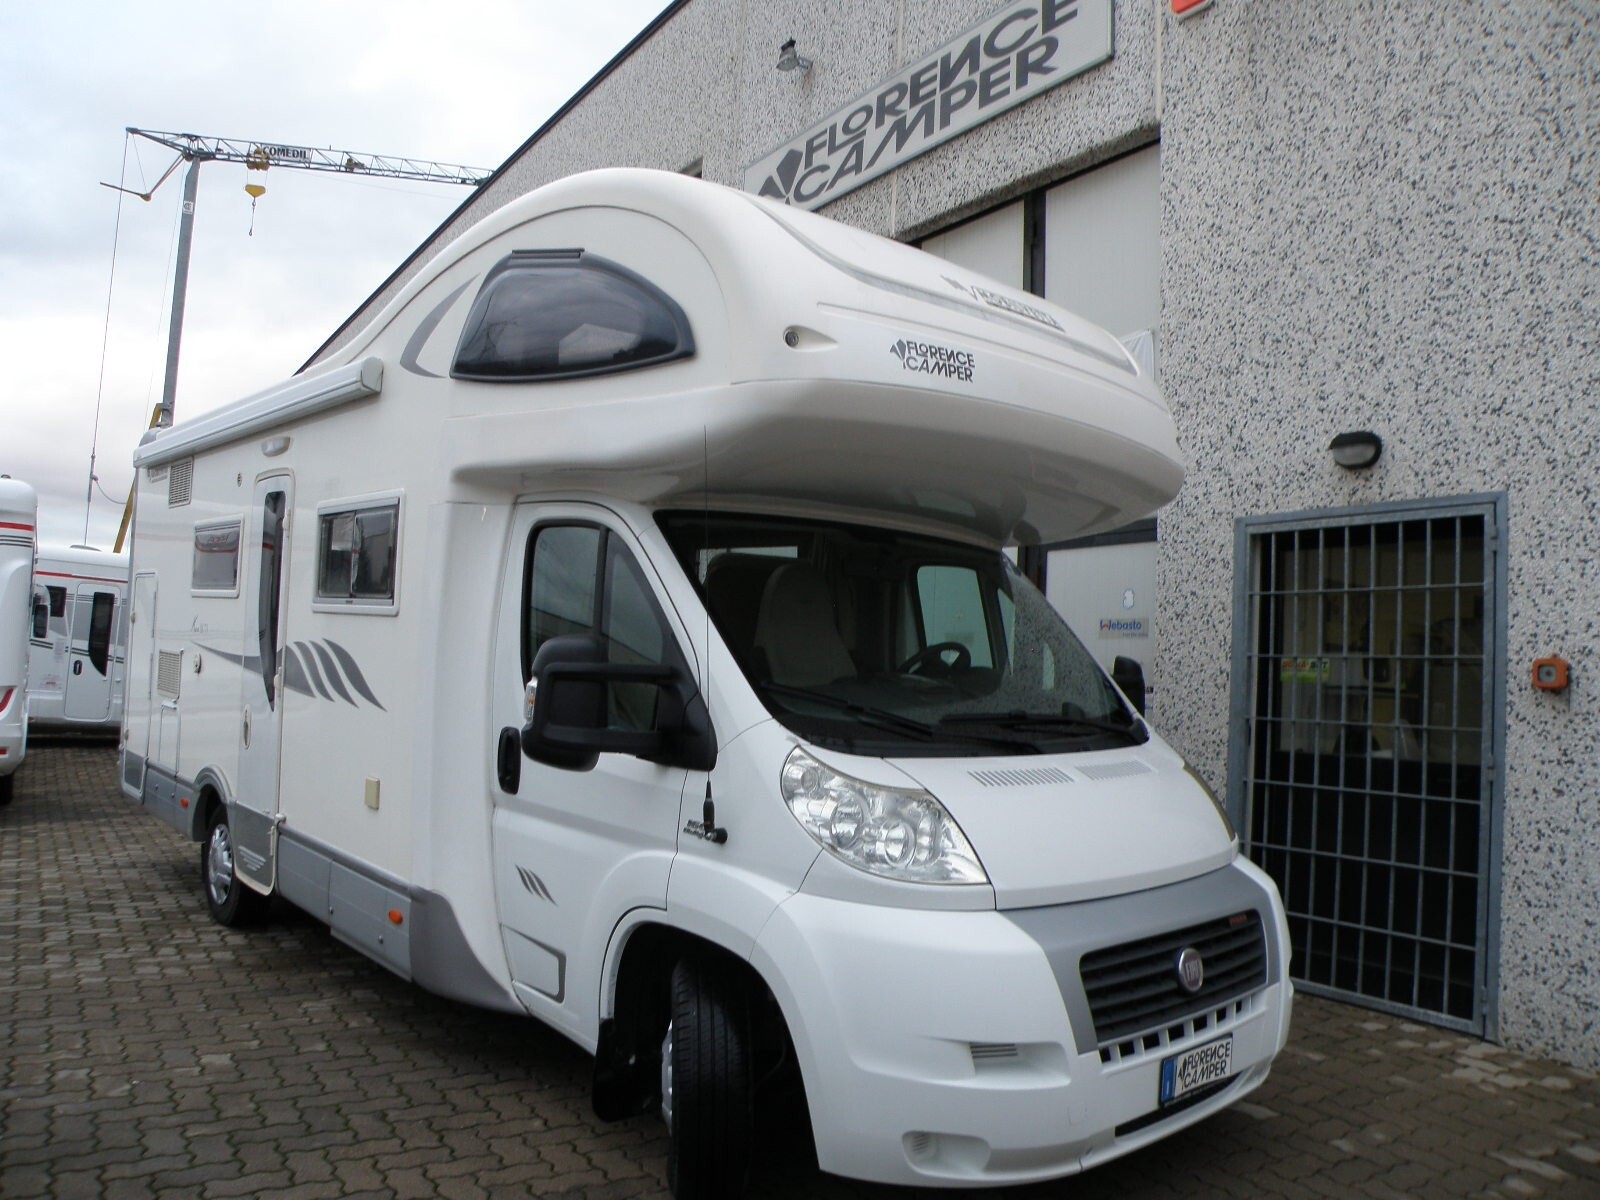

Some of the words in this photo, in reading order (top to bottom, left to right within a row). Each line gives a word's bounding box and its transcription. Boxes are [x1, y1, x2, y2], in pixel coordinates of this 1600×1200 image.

[803, 0, 1079, 169] FLORENCE
[792, 34, 1061, 203] CAMPER
[906, 340, 975, 368] FLORENCE
[906, 355, 974, 383] CAMPER
[1099, 619, 1142, 631] Webasto
[1186, 1042, 1231, 1072] FLORENCE
[1183, 1060, 1227, 1088] CAMPER
